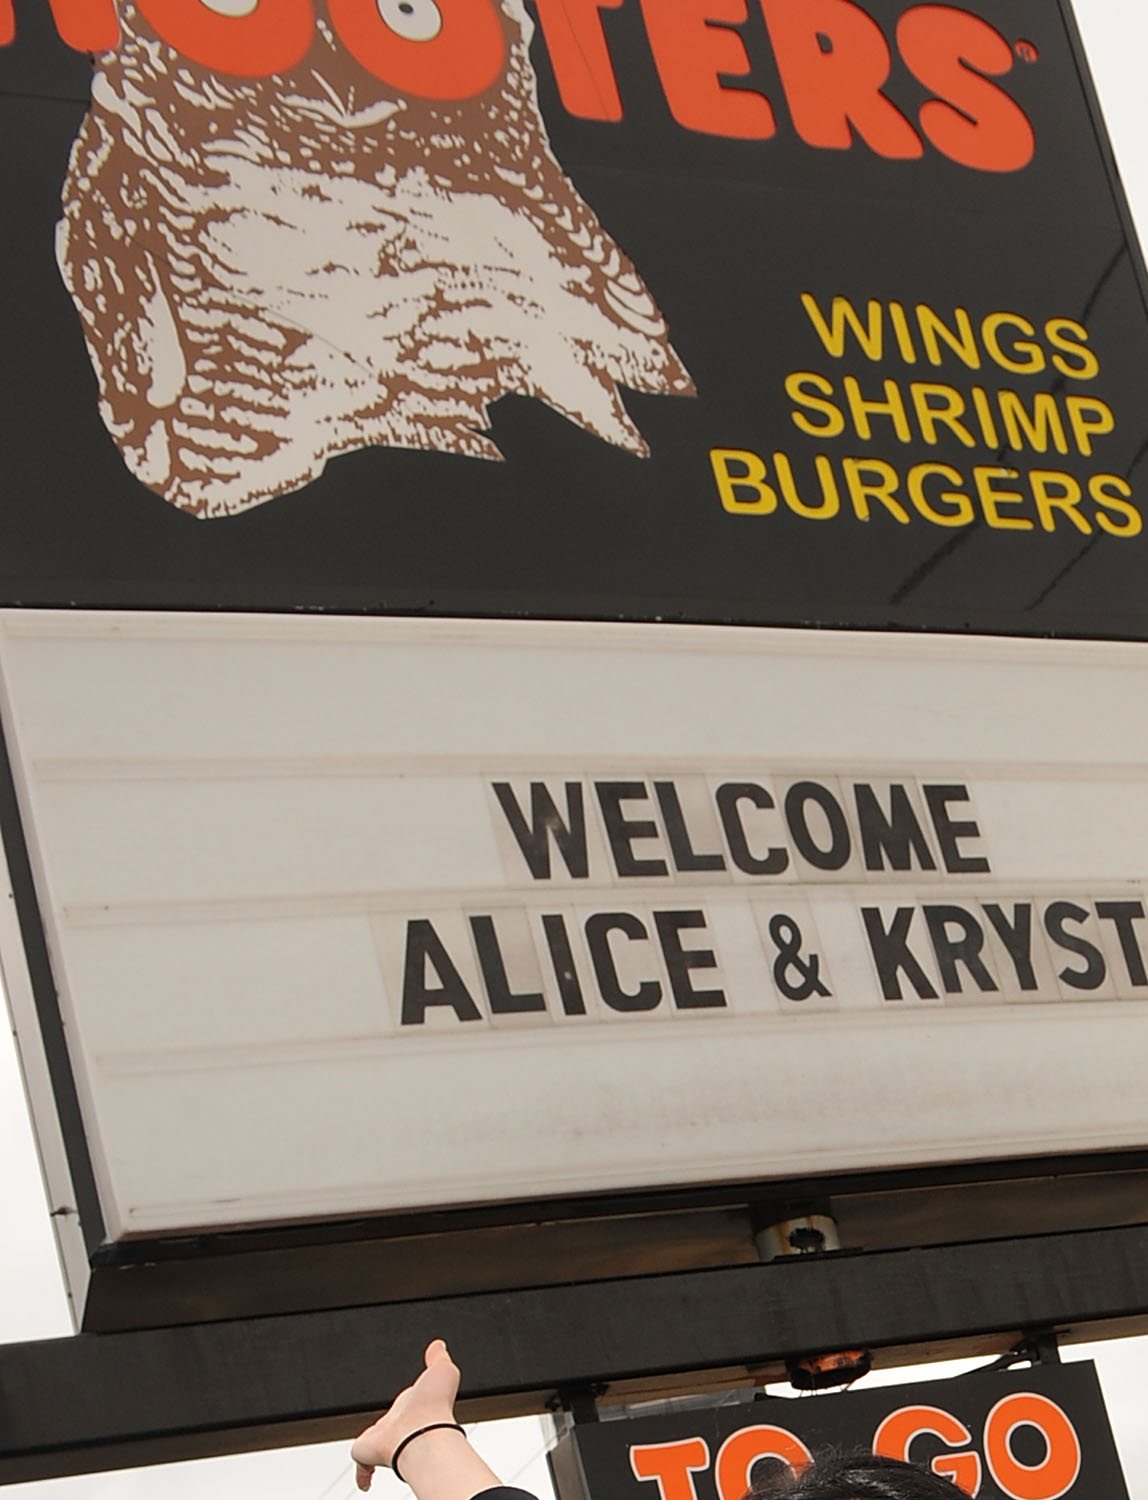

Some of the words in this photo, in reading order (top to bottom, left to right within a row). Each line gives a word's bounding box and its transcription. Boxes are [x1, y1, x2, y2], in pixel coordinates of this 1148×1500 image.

[800, 293, 1100, 380] WINGS
[784, 371, 1115, 457] SHRIMP
[709, 448, 1143, 537] BURGERS
[491, 780, 991, 880] WELCOME
[400, 909, 728, 1026] ALICE
[768, 913, 833, 1002] &
